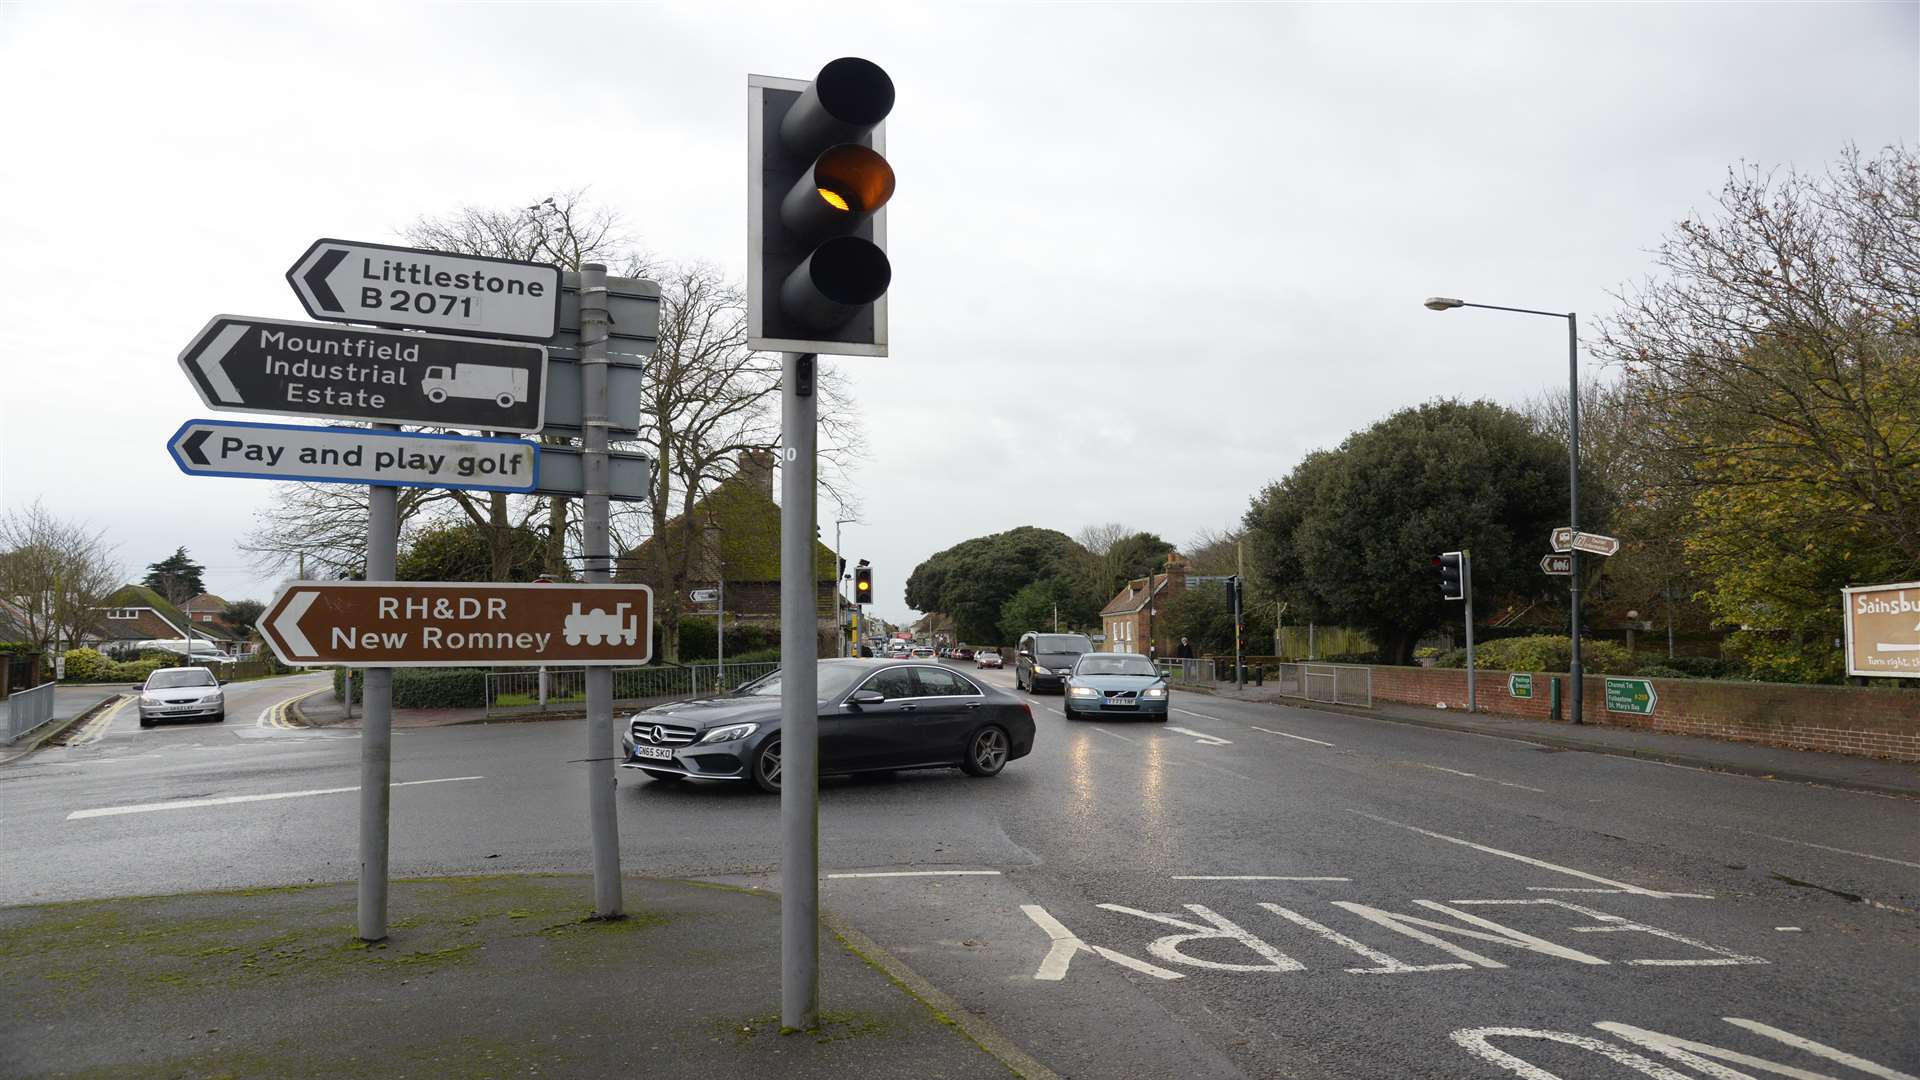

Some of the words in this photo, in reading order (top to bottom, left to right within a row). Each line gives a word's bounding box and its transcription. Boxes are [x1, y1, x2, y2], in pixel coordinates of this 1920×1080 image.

[362, 258, 545, 297] Littlestone
[260, 330, 419, 362] Mountfield
[265, 355, 407, 386] Industrial
[287, 383, 385, 408] Estate
[221, 436, 285, 467] Pay
[298, 444, 363, 467] and
[375, 447, 446, 475] play
[457, 453, 523, 477] golf
[378, 596, 507, 620] RH&DR
[331, 626, 408, 649] New
[423, 626, 551, 653] Romney
[1019, 899, 1771, 981] ENTRY
